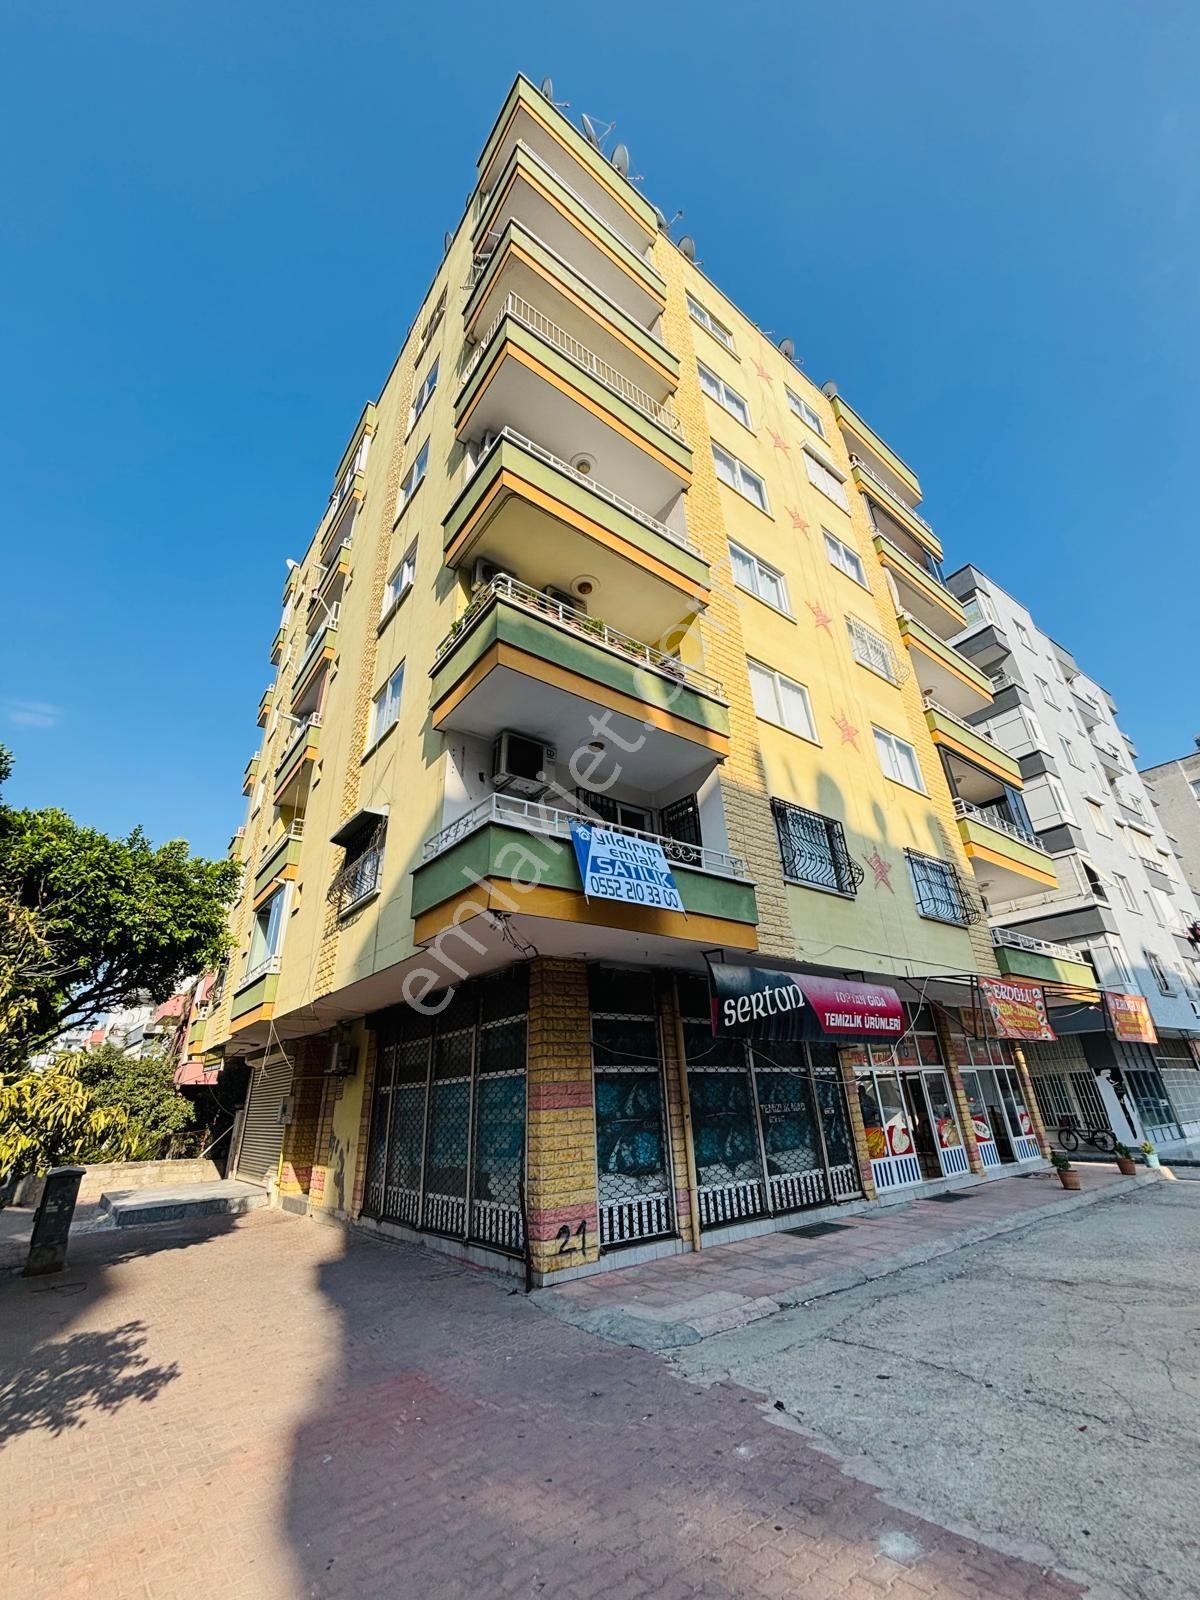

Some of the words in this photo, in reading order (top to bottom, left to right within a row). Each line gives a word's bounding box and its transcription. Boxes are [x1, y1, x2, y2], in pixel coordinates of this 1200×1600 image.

[609, 848, 658, 870] emlak
[596, 858, 672, 888] SATILIK
[591, 876, 623, 899] 0552
[625, 882, 645, 901] 210
[648, 885, 661, 904] 33
[663, 890, 679, 909] 00
[833, 991, 867, 1006] TOPTAN
[867, 995, 887, 1008] GIDA
[992, 983, 1033, 1003] EROĞLU
[824, 1011, 863, 1028] TEMİZLİK
[864, 1013, 902, 1031] ÜRÜNLERİ
[555, 1219, 587, 1257] 21
